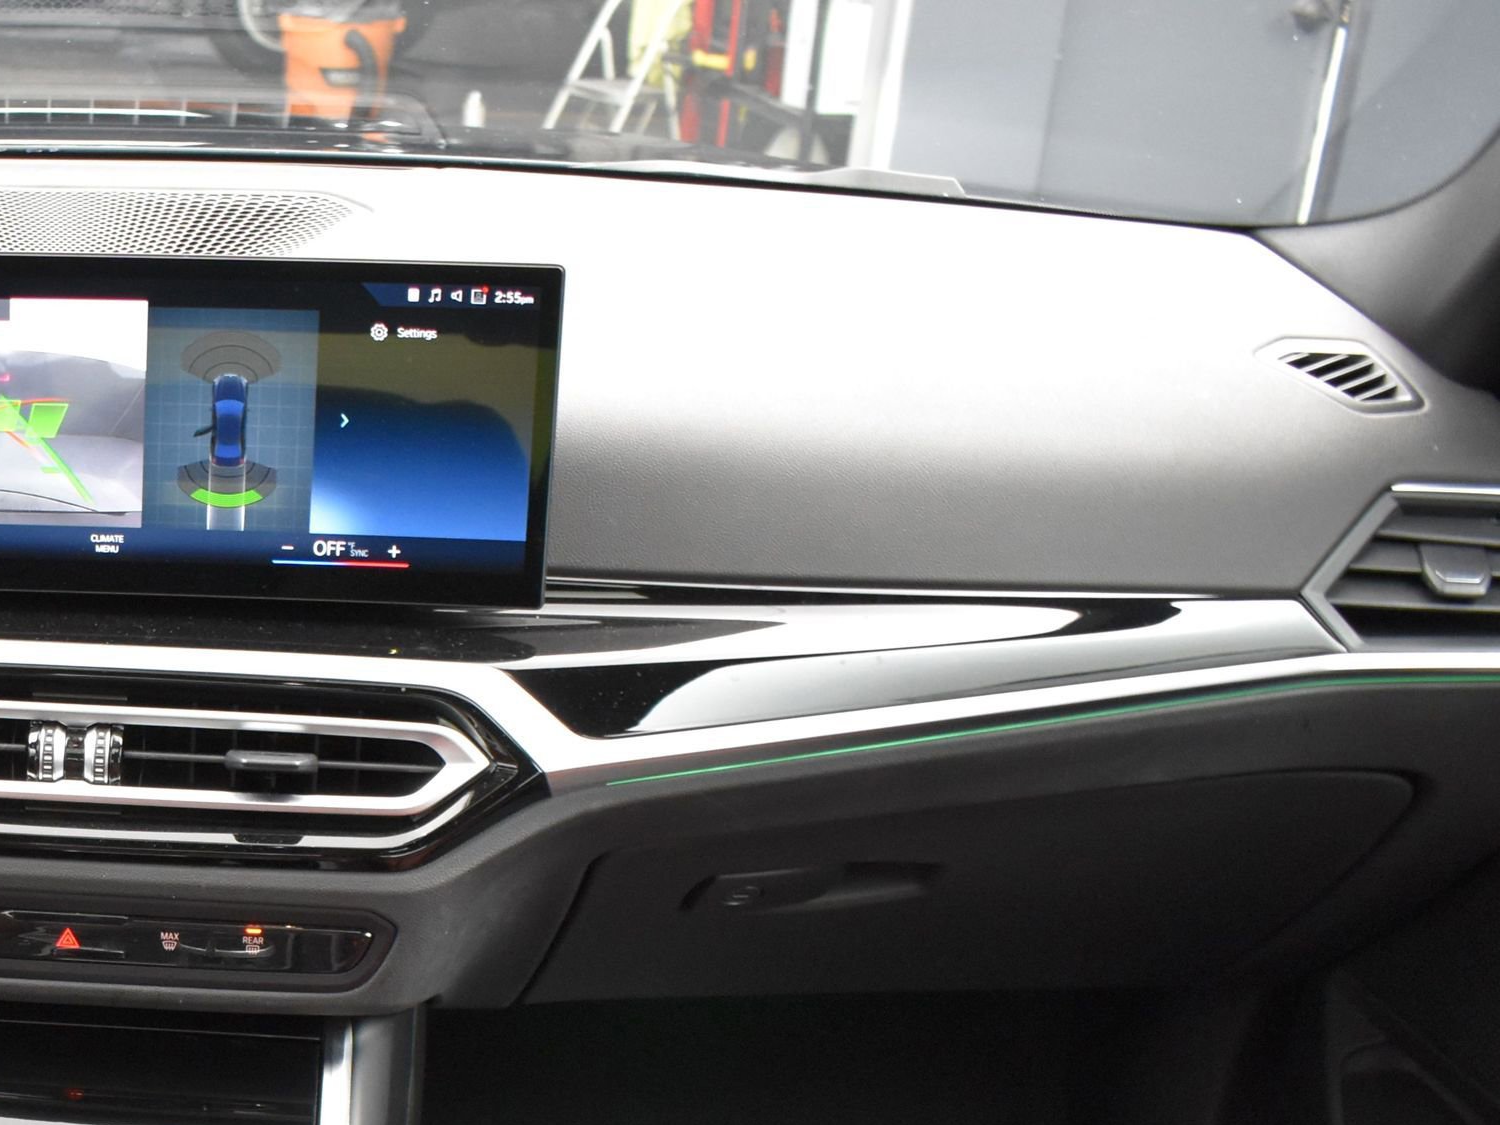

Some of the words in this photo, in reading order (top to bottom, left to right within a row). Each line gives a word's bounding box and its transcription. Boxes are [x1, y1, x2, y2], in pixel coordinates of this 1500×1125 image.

[494, 291, 534, 305] 2:55pm
[397, 326, 438, 340] Settings
[90, 534, 124, 544] CLIMATE
[95, 544, 119, 554] MENU
[312, 539, 347, 557] OFF
[350, 549, 370, 558] SYNC
[160, 932, 180, 940] MAX
[242, 936, 264, 945] REAR
